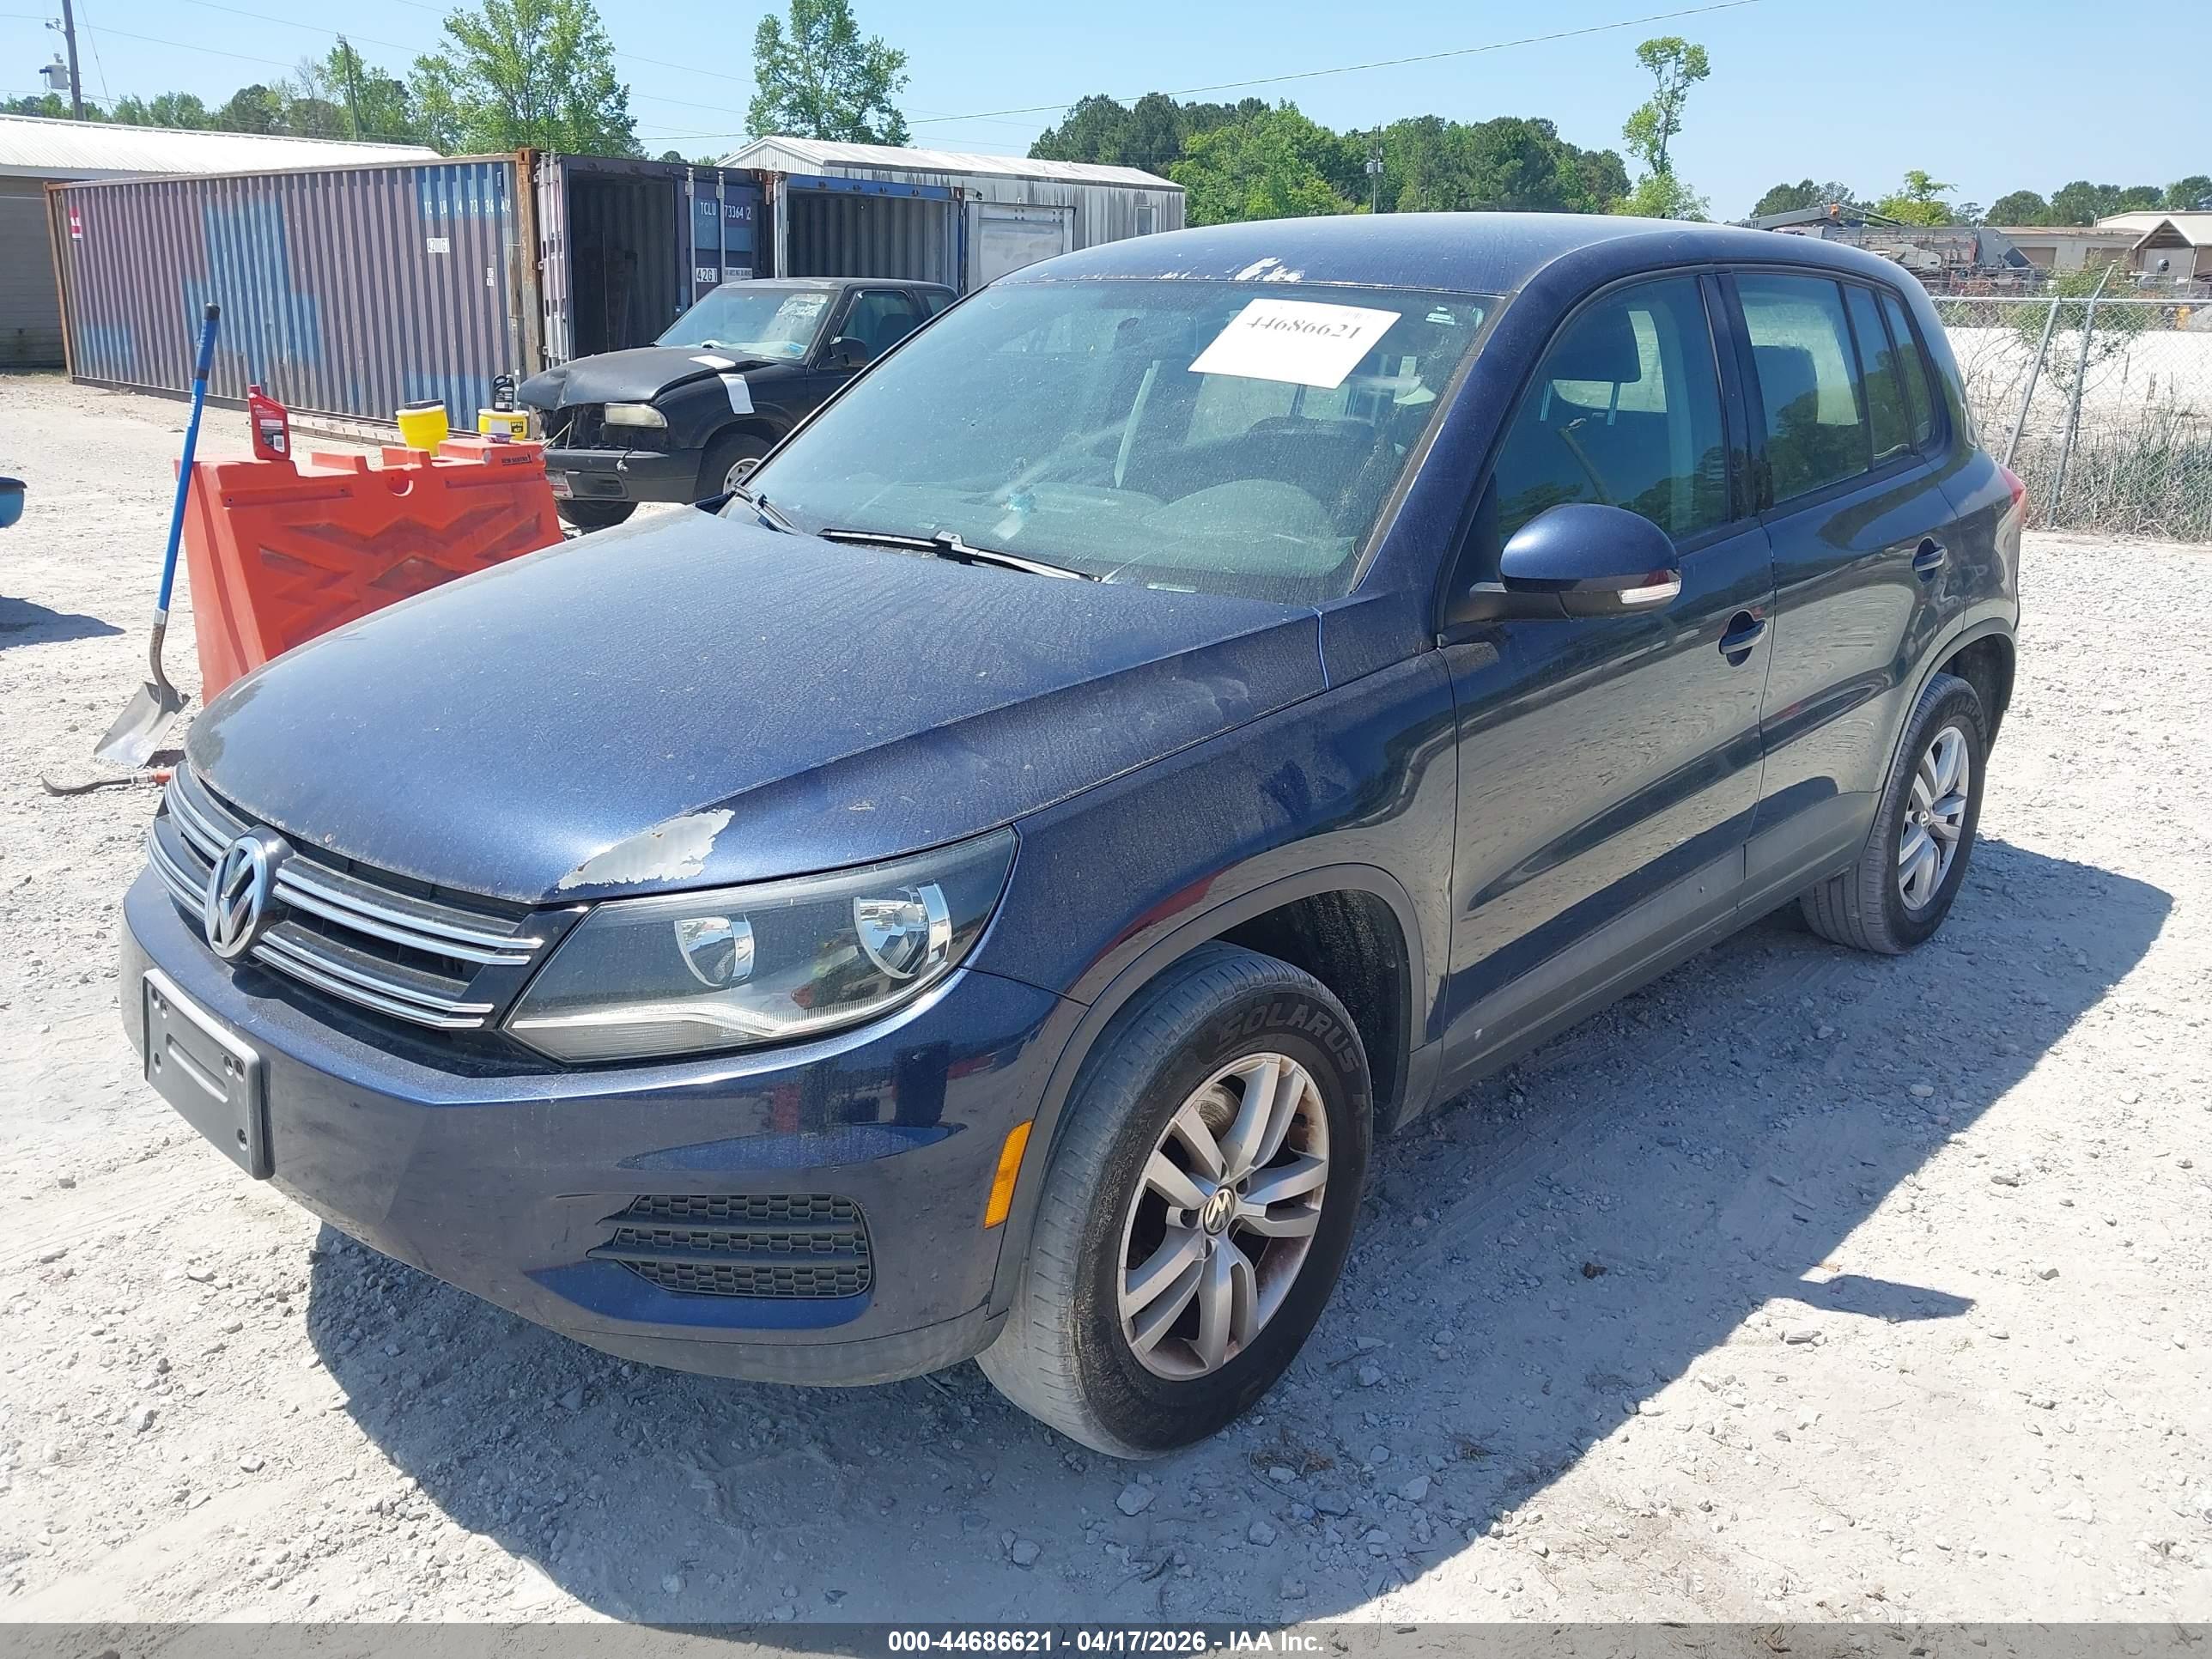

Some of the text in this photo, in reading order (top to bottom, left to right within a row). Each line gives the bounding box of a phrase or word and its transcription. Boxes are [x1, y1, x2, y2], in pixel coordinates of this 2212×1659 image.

[700, 202, 716, 216] TCLU
[697, 268, 717, 282] 42G1
[1247, 316, 1362, 338] 44686621
[1216, 1002, 1360, 1073] SOLARUS
